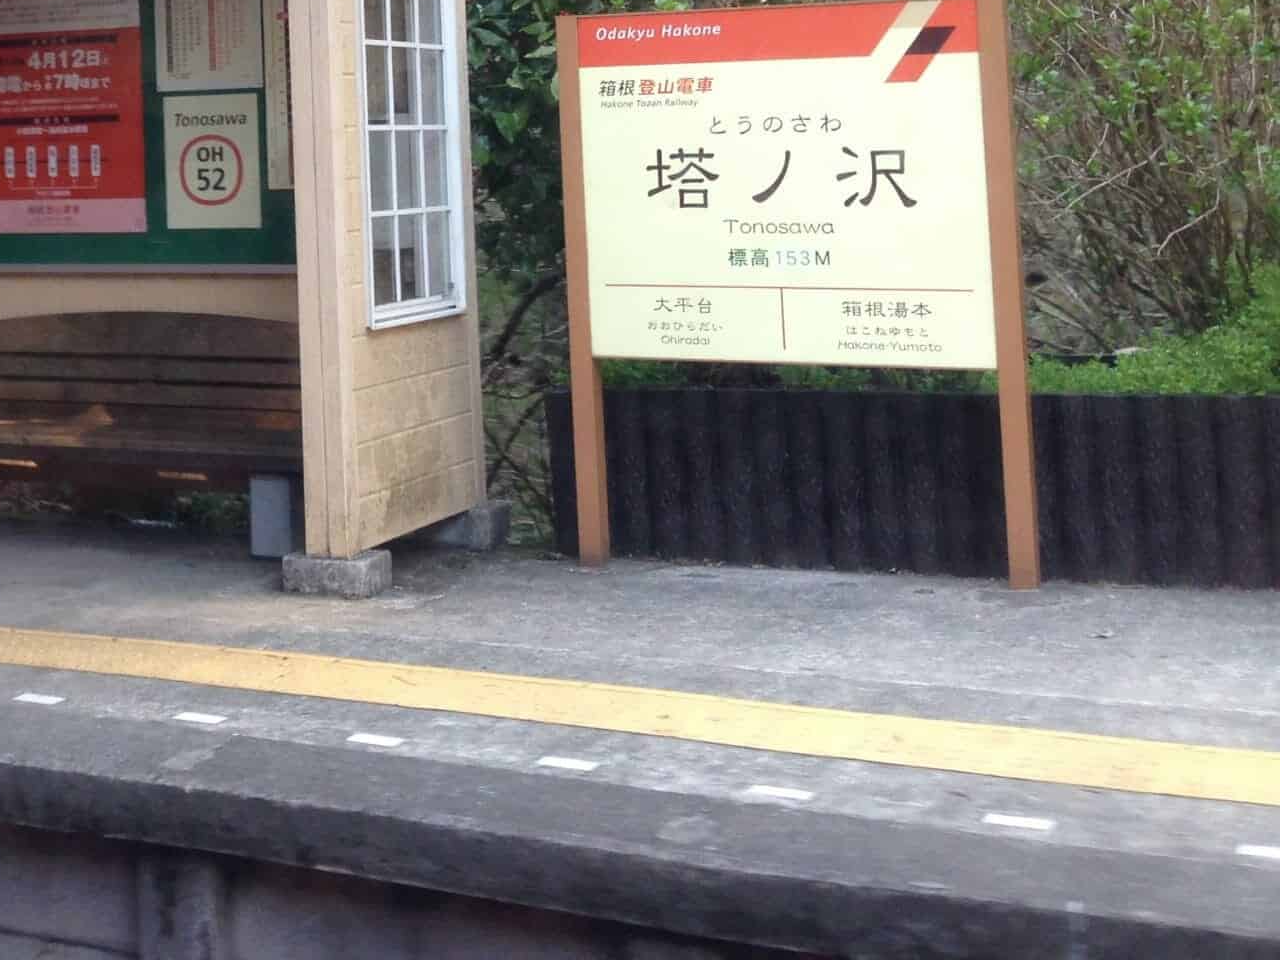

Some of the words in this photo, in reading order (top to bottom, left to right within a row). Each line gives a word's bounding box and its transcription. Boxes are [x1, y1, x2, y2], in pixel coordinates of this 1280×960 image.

[596, 26, 656, 41] Odakyu
[661, 23, 721, 38] Hakone
[599, 76, 713, 97] 箱根登山電車
[600, 100, 633, 108] Hakone
[665, 98, 698, 107] Railway
[174, 113, 247, 127] Tonosawa
[709, 114, 843, 135] とうのさわ
[197, 146, 224, 162] OH
[197, 168, 226, 191] 52
[646, 147, 917, 208] 塔ノ沢
[723, 219, 835, 235] Tonosawa
[653, 297, 713, 314] 大平台
[841, 301, 932, 318] 箱根湯本
[647, 321, 723, 332] おおひらだい
[846, 326, 929, 337] はこねゆもと
[661, 335, 711, 346] Ohiradai
